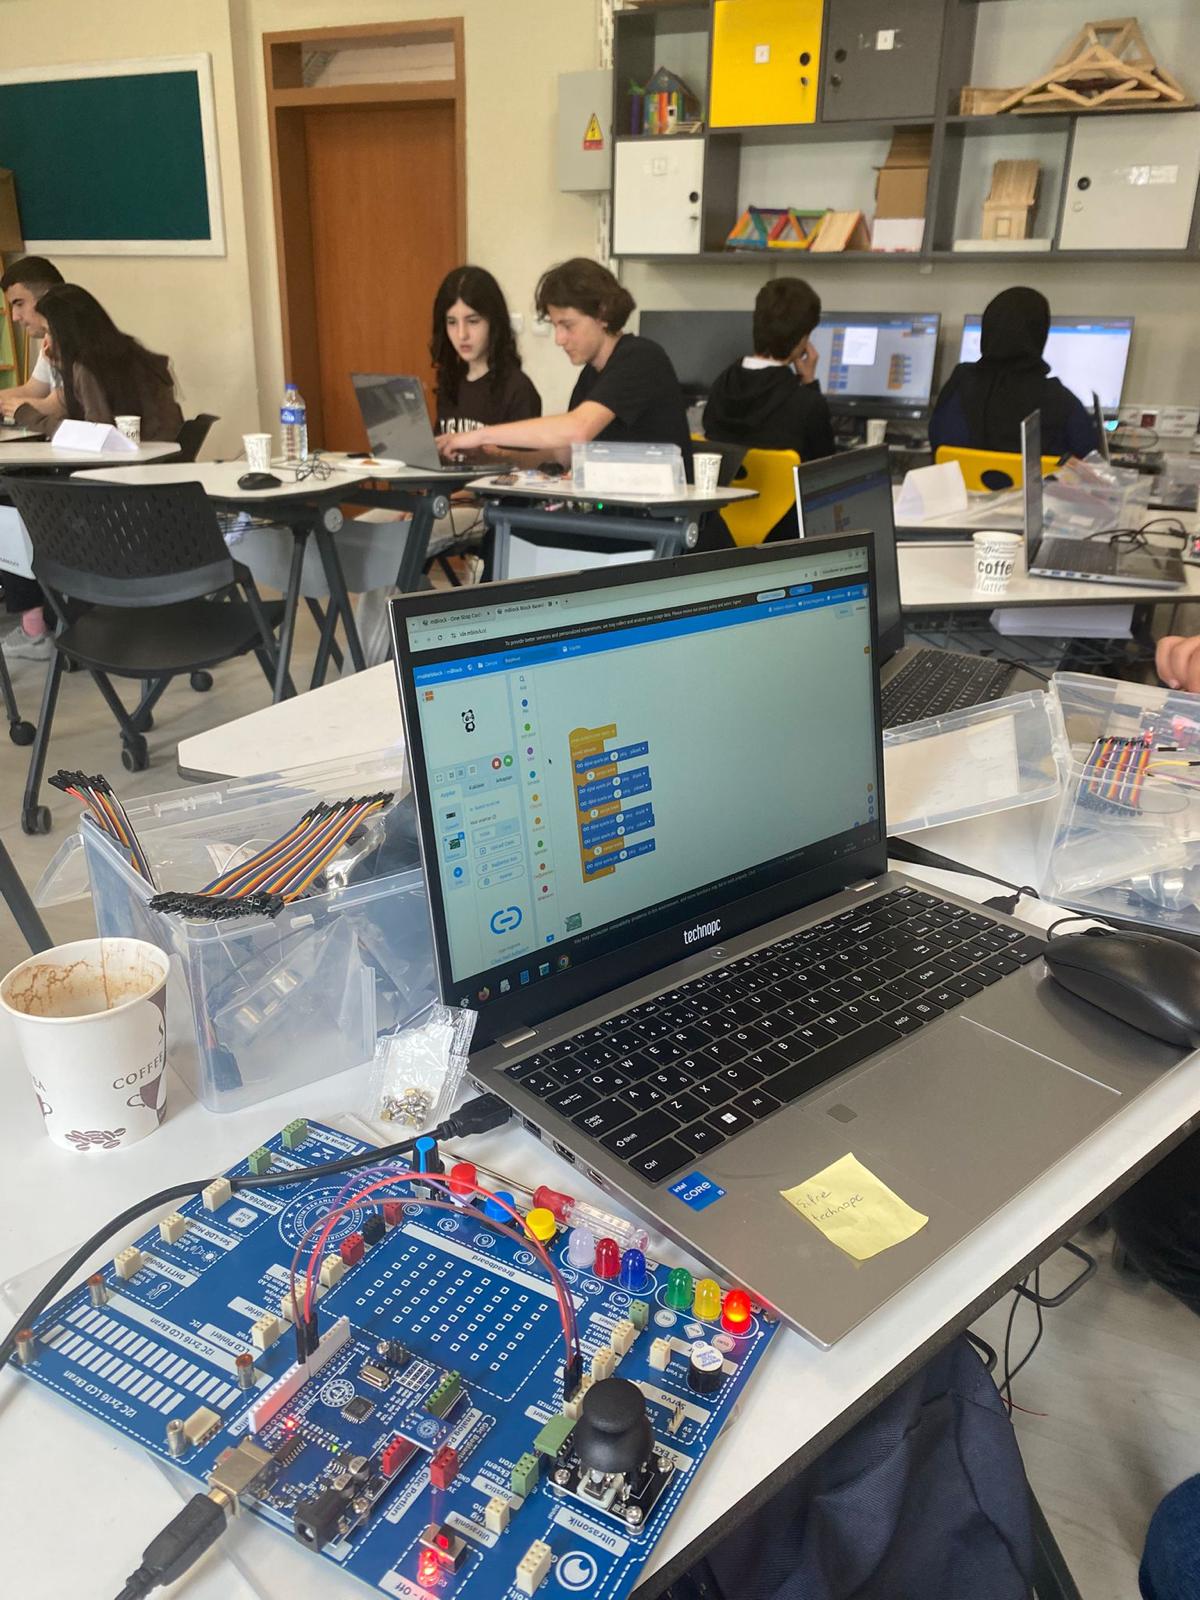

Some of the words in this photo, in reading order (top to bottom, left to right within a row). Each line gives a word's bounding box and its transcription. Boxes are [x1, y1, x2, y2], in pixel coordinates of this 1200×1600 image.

[683, 918, 721, 945] technopc
[761, 1020, 773, 1028] H
[826, 1016, 838, 1025] M
[676, 1033, 687, 1041] R
[802, 1029, 814, 1037] N
[649, 1046, 660, 1054] E
[711, 1046, 720, 1054] F
[777, 1042, 788, 1050] B
[621, 1059, 634, 1068] W
[684, 1060, 695, 1068] D
[753, 1055, 763, 1063] V
[657, 1075, 668, 1083] S
[727, 1070, 738, 1078] C
[629, 1090, 639, 1099] A
[699, 1085, 710, 1093] X
[671, 1100, 683, 1109] Z
[470, 1250, 516, 1280] Breadboard
[148, 1315, 171, 1332] Ekran
[168, 1326, 184, 1340] LCD
[209, 1328, 234, 1347] Pinleri
[182, 1334, 199, 1348] 2x16
[197, 1342, 215, 1356] I2C
[61, 1368, 87, 1388] Ekran
[84, 1382, 103, 1398] LCD
[99, 1391, 123, 1410] 2x16
[659, 1392, 686, 1411] Servo
[119, 1403, 137, 1419] I2C
[452, 1409, 476, 1438] Analog
[483, 1458, 511, 1478] Ekseni
[412, 1469, 430, 1488] Güç
[477, 1466, 505, 1485] Ekseni
[482, 1481, 512, 1502] Joystick
[452, 1516, 491, 1542] Ultrasonik
[565, 1514, 617, 1548] Ultrasonik
[394, 1580, 413, 1596] Off
